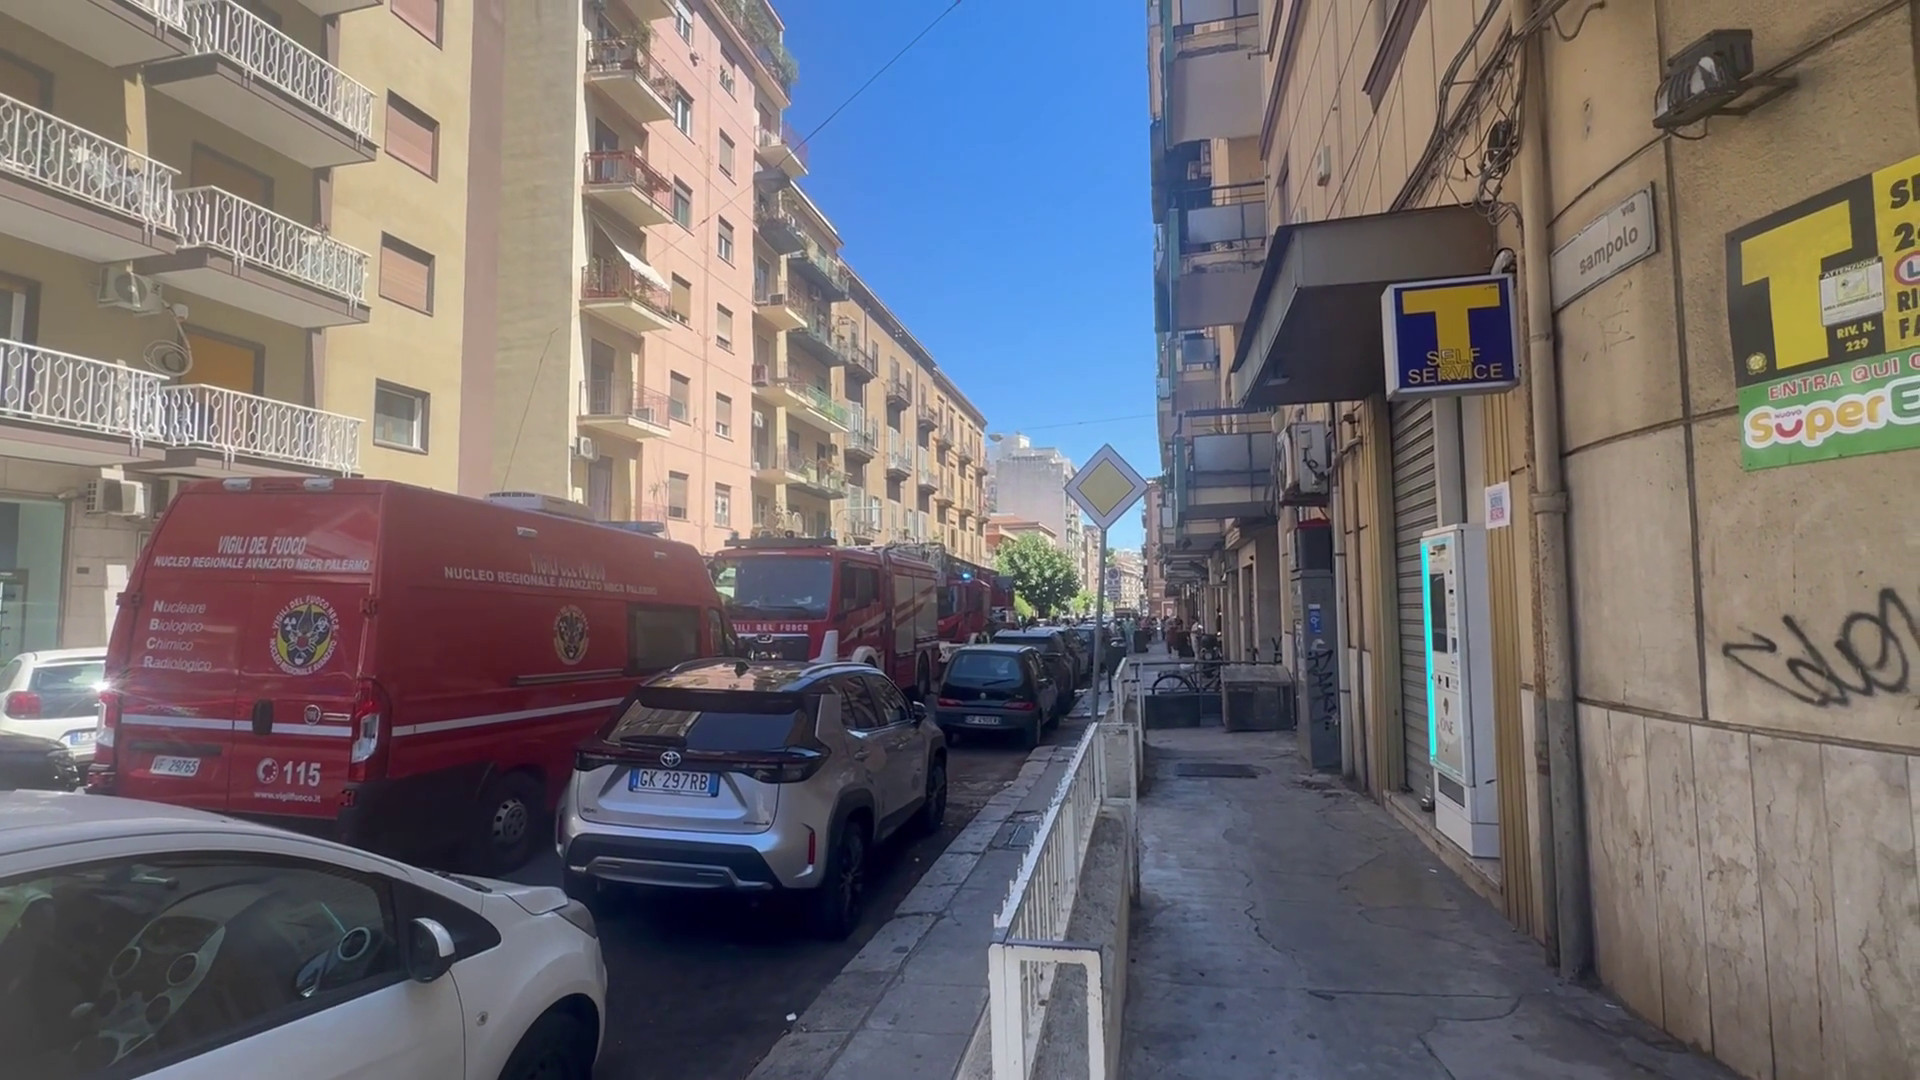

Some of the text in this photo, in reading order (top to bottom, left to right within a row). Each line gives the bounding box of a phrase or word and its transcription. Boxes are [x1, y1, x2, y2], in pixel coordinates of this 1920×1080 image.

[1621, 202, 1636, 216] via
[1580, 226, 1638, 275] sampolo
[1837, 321, 1876, 339] RIV. N.
[1845, 338, 1869, 352] 229
[1426, 347, 1480, 366] SELF
[1408, 363, 1503, 384] SERVICE
[1769, 372, 1842, 400] ENTRA
[1852, 357, 1900, 383] QUI
[1774, 409, 1802, 418] NUOVO
[218, 536, 307, 555] VIGILI DEL FUOCO
[154, 556, 370, 571] NUCLEO REGIONALE AVANZATO NBCR PALERMO
[445, 566, 495, 581] NUCLEO
[498, 571, 557, 587] REGIONALE
[558, 578, 601, 590] AVANZATO
[153, 600, 206, 613] Nucleare
[289, 598, 304, 608] DEL
[149, 618, 203, 635] Biologico
[146, 637, 194, 651] Chimico
[144, 656, 212, 673] Radiologico
[168, 759, 198, 773] 29765
[283, 761, 321, 786] 115
[640, 770, 709, 791] GK 297RB
[254, 792, 321, 803] www.vigilfuoco.it
